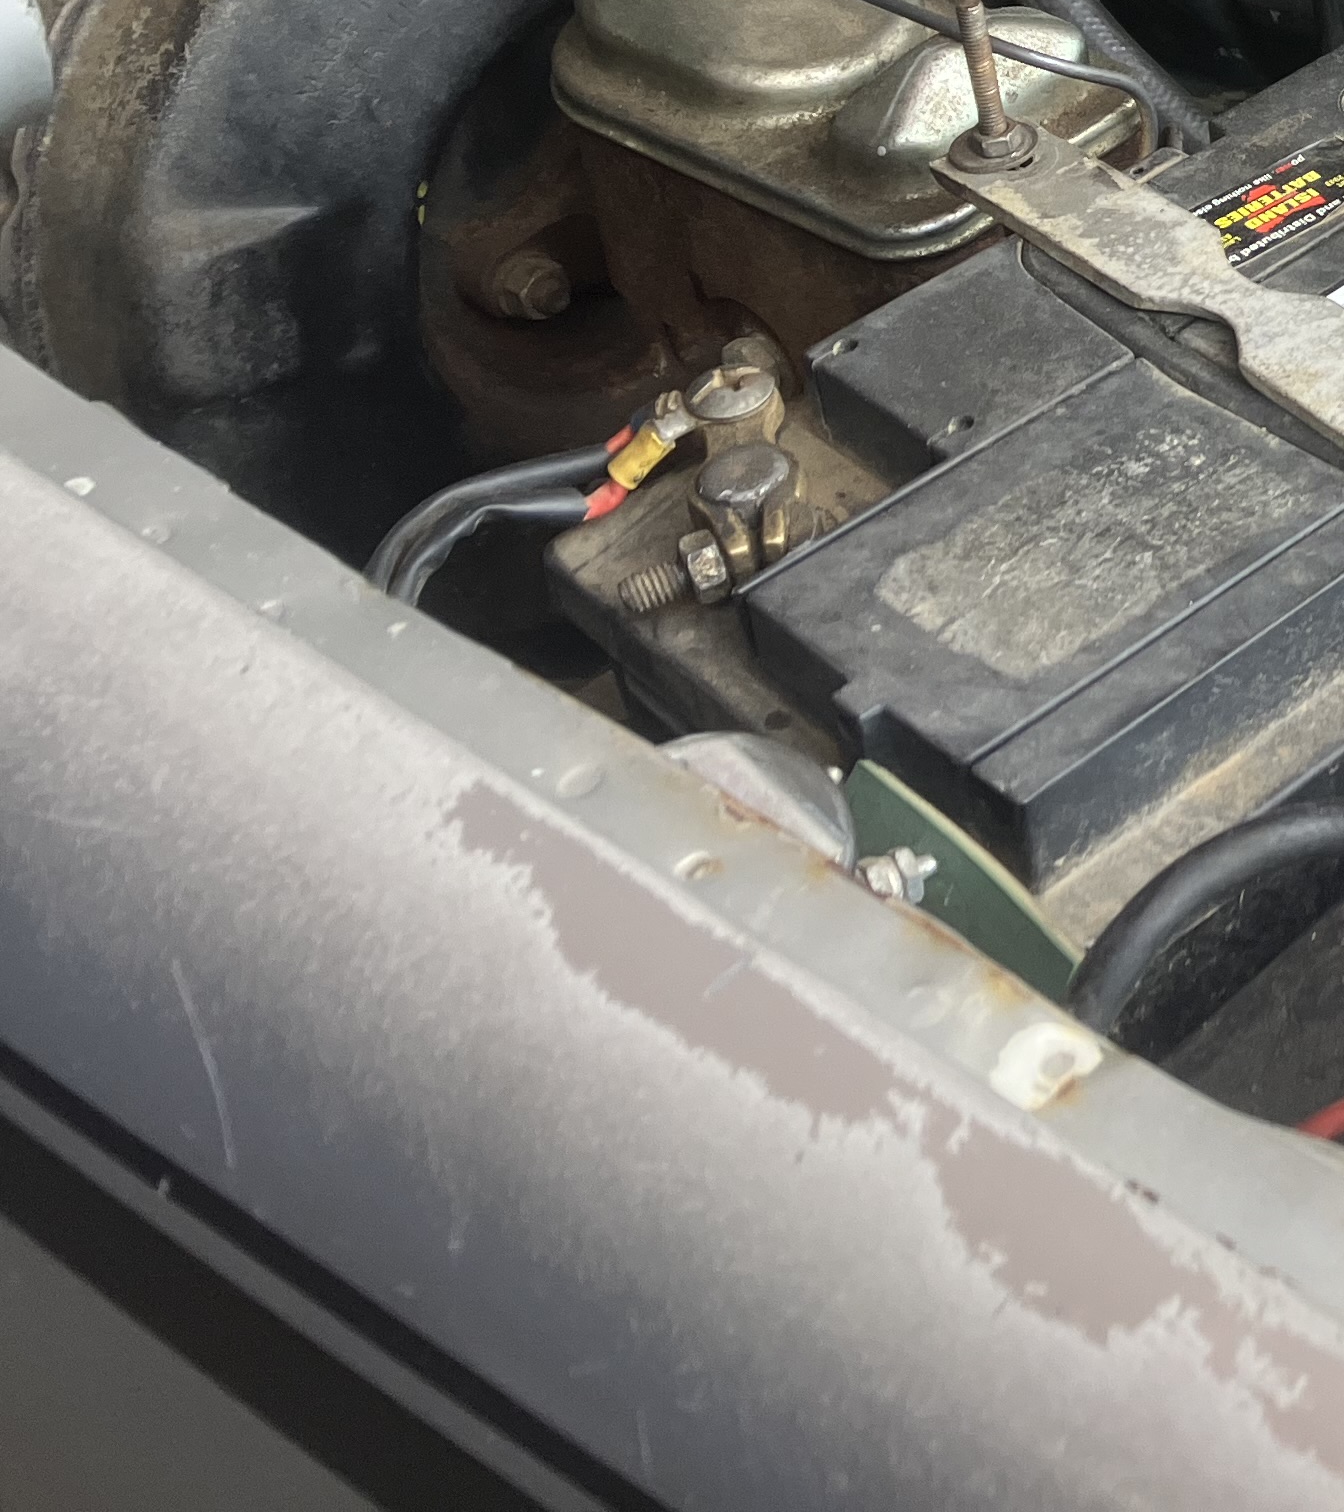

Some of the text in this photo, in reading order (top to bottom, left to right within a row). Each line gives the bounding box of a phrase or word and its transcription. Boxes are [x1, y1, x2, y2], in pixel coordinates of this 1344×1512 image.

[1212, 182, 1256, 207] nothing
[1253, 172, 1273, 186] like
[1213, 170, 1321, 229] BATTERIES
[1244, 187, 1321, 230] ISLAND
[1315, 198, 1342, 215] and
[1240, 213, 1316, 256] Distributed
